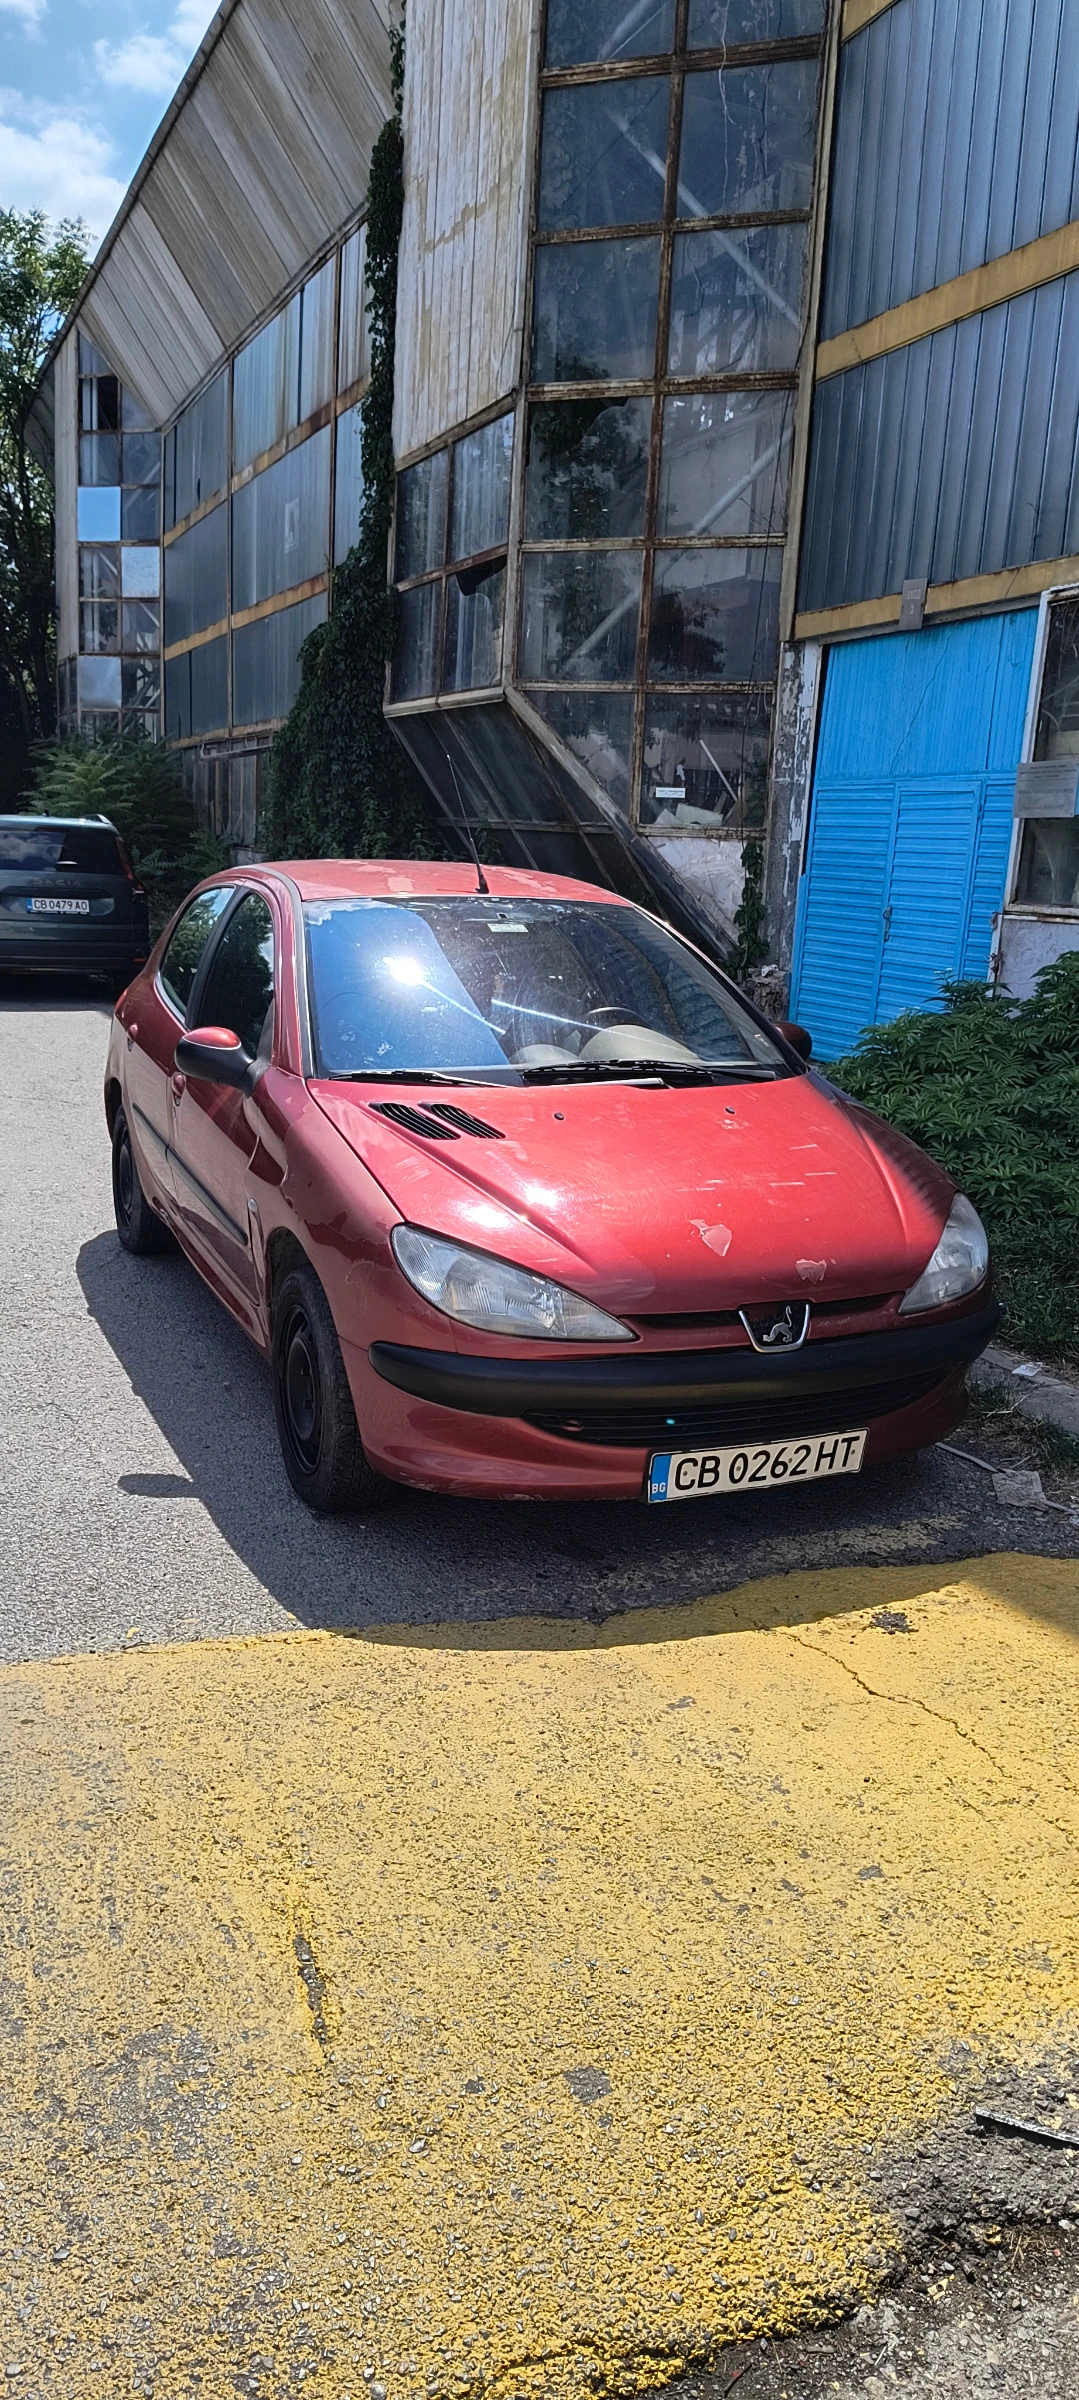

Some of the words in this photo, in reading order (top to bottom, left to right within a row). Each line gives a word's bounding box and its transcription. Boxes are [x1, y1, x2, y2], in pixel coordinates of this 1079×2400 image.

[34, 899, 47, 909] CB
[49, 900, 72, 910] 0479
[674, 1456, 720, 1491] CB
[728, 1445, 811, 1484] 0262
[814, 1436, 860, 1472] HT
[652, 1482, 667, 1494] BG
